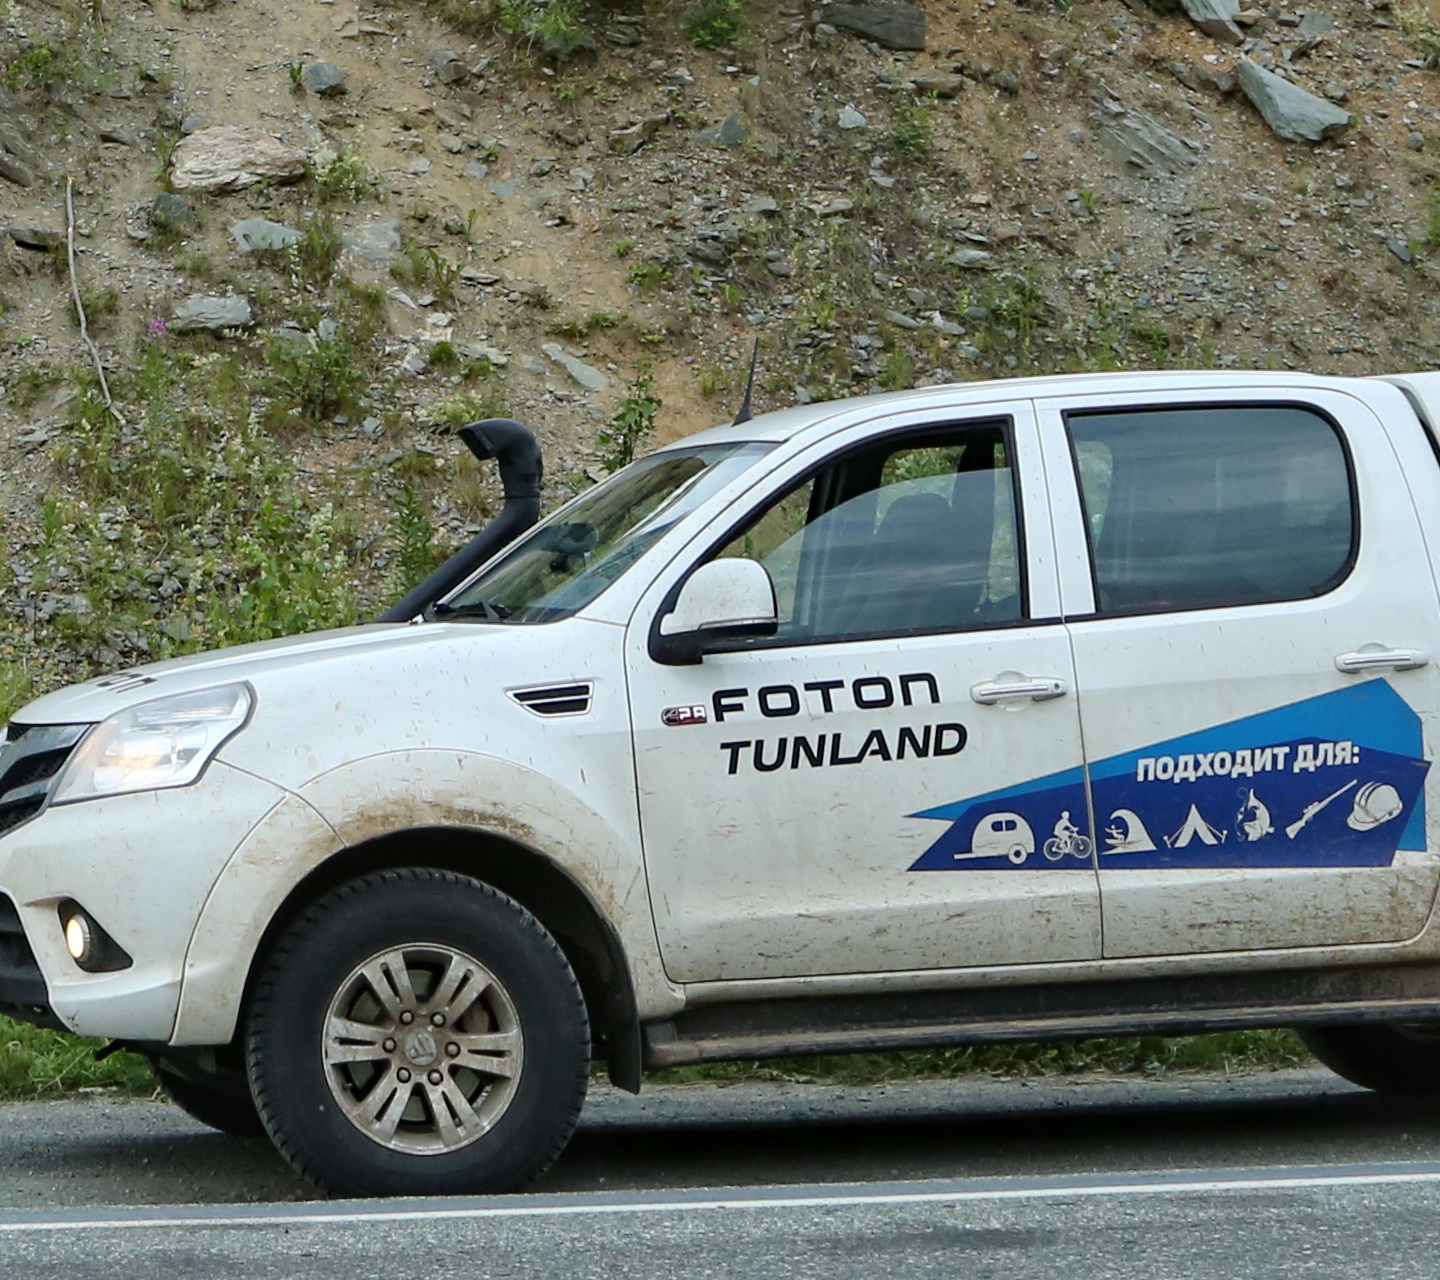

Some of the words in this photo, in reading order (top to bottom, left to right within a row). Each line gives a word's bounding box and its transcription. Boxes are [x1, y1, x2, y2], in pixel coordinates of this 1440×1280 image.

[712, 672, 941, 723] FOTON
[720, 722, 968, 775] TUNLAND
[1136, 746, 1291, 784] ПОДХОДИТ
[1292, 740, 1360, 774] ДЛЯ:
